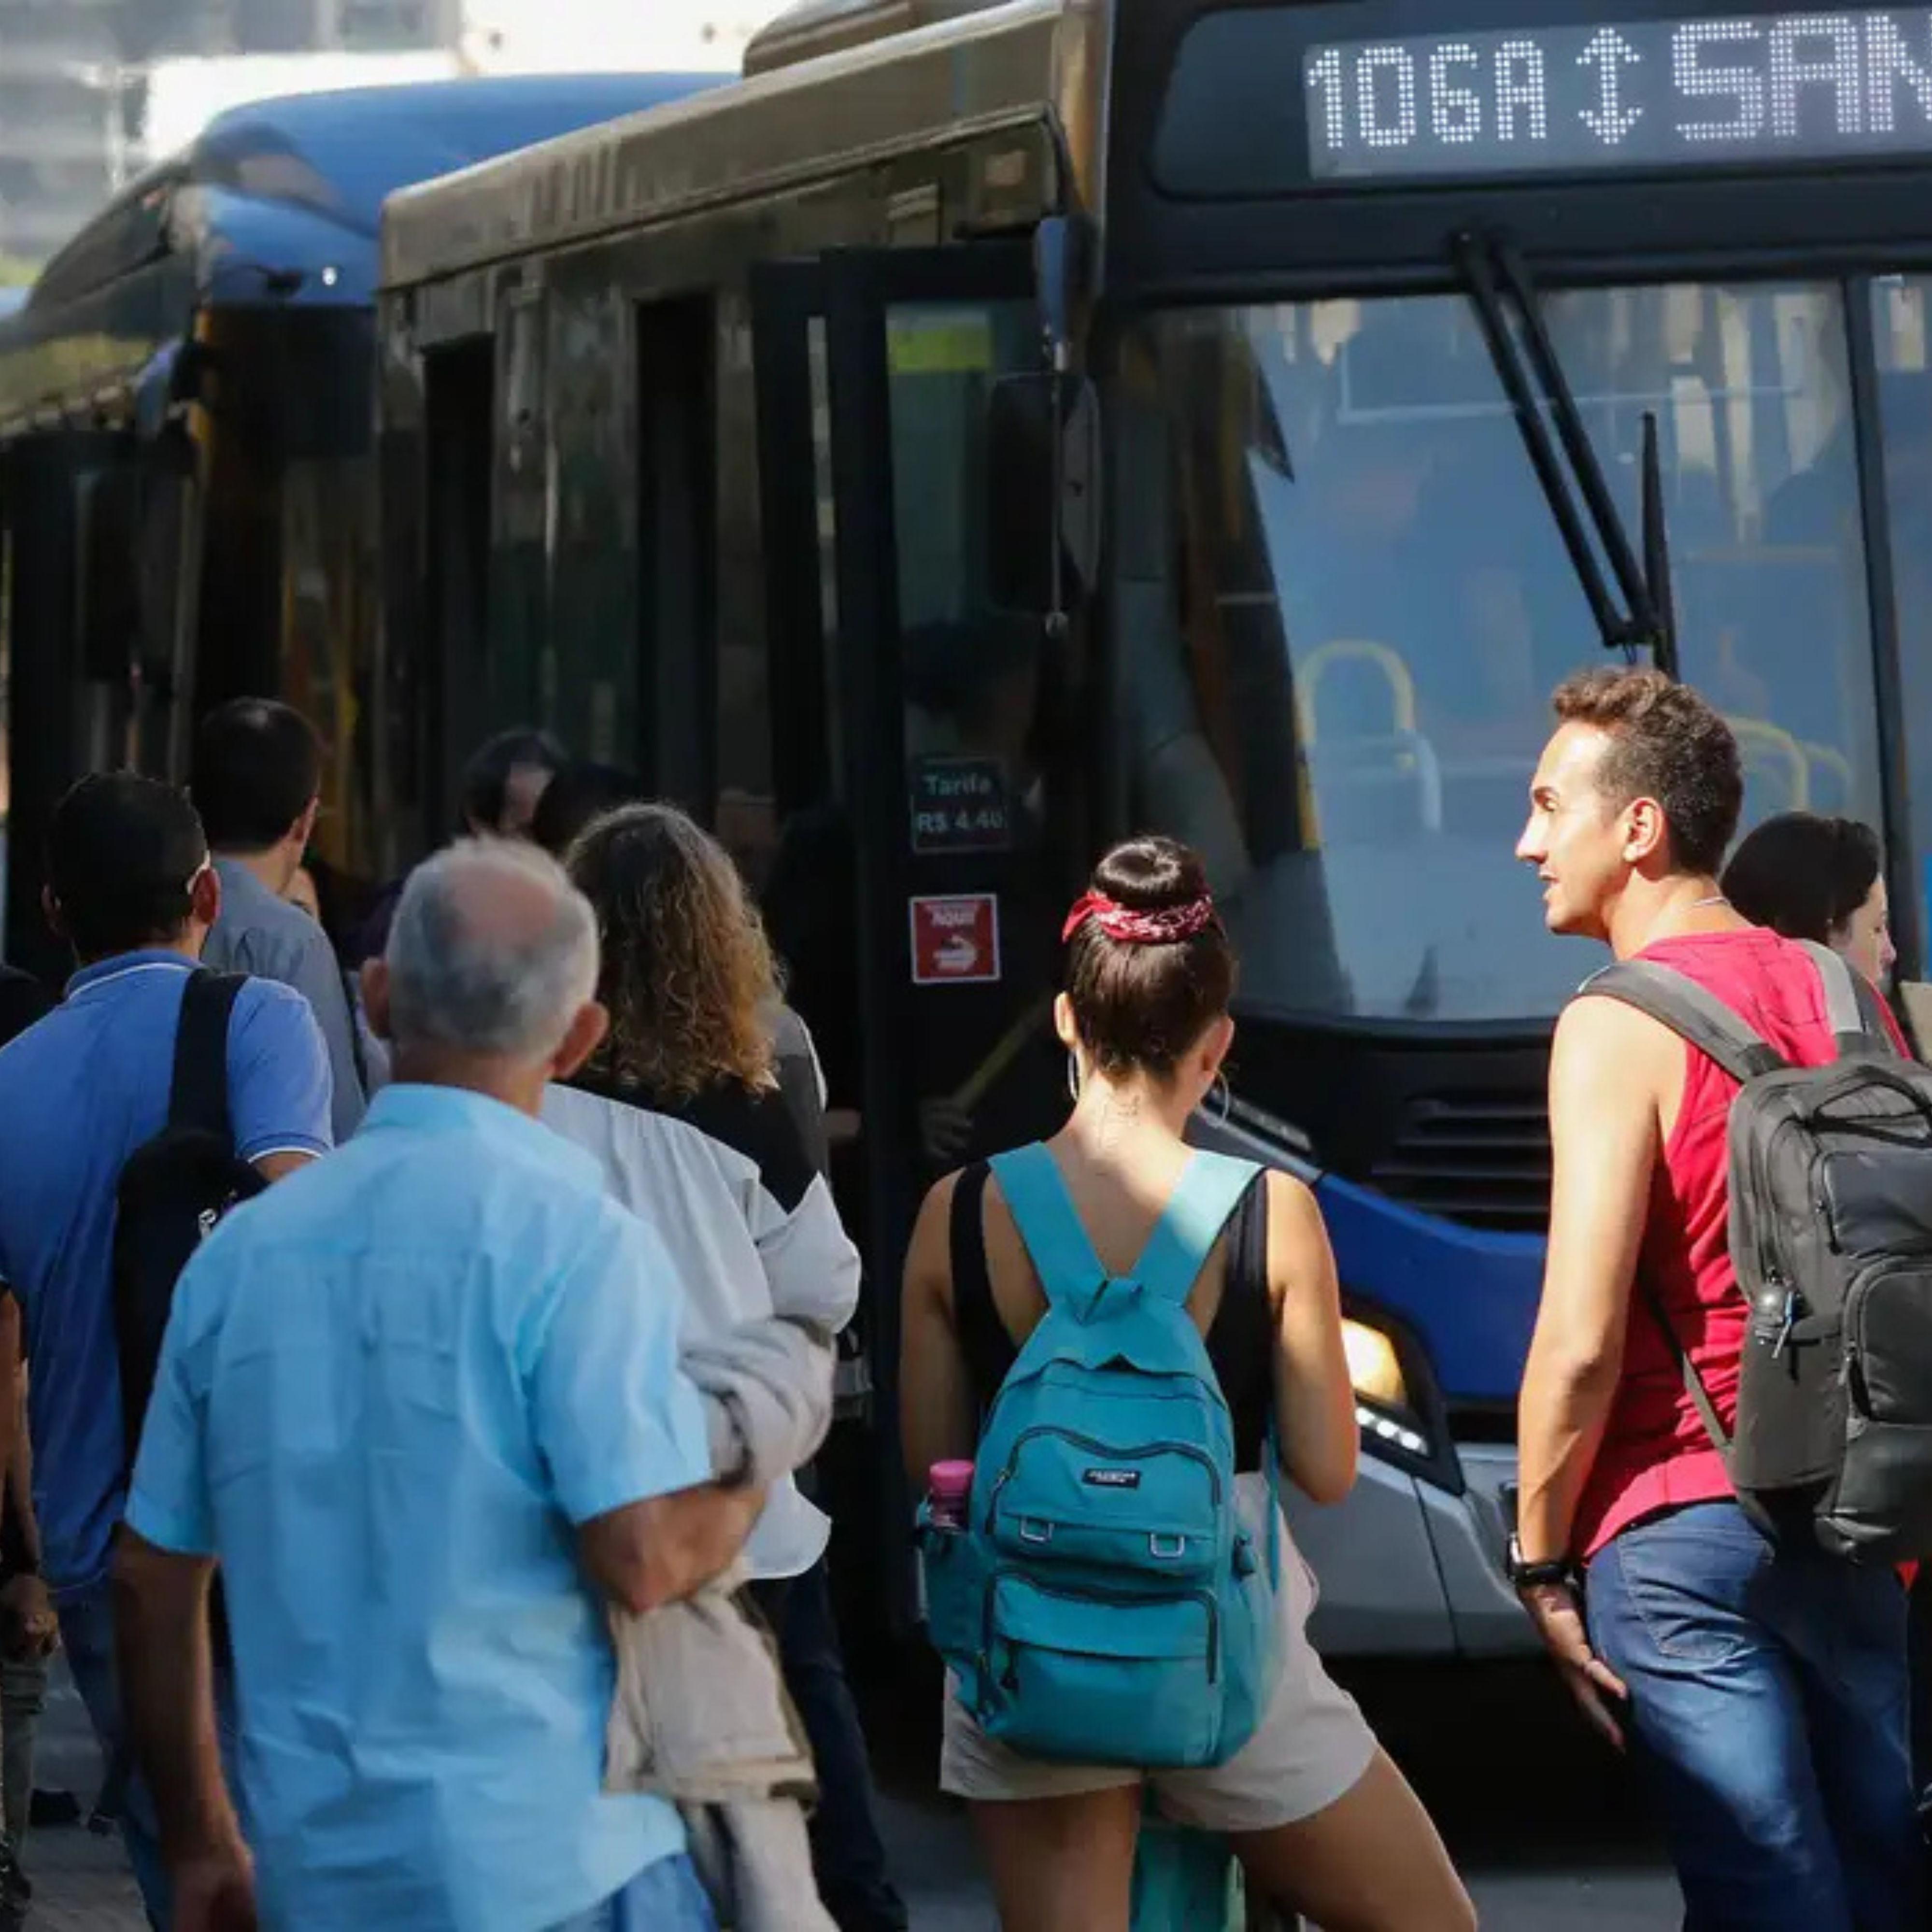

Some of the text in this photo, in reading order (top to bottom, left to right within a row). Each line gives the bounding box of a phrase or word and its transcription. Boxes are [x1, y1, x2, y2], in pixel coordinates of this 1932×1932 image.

[1307, 15, 1932, 148] 106A SAN
[922, 772, 992, 796] Tarifa
[918, 810, 946, 833] R$
